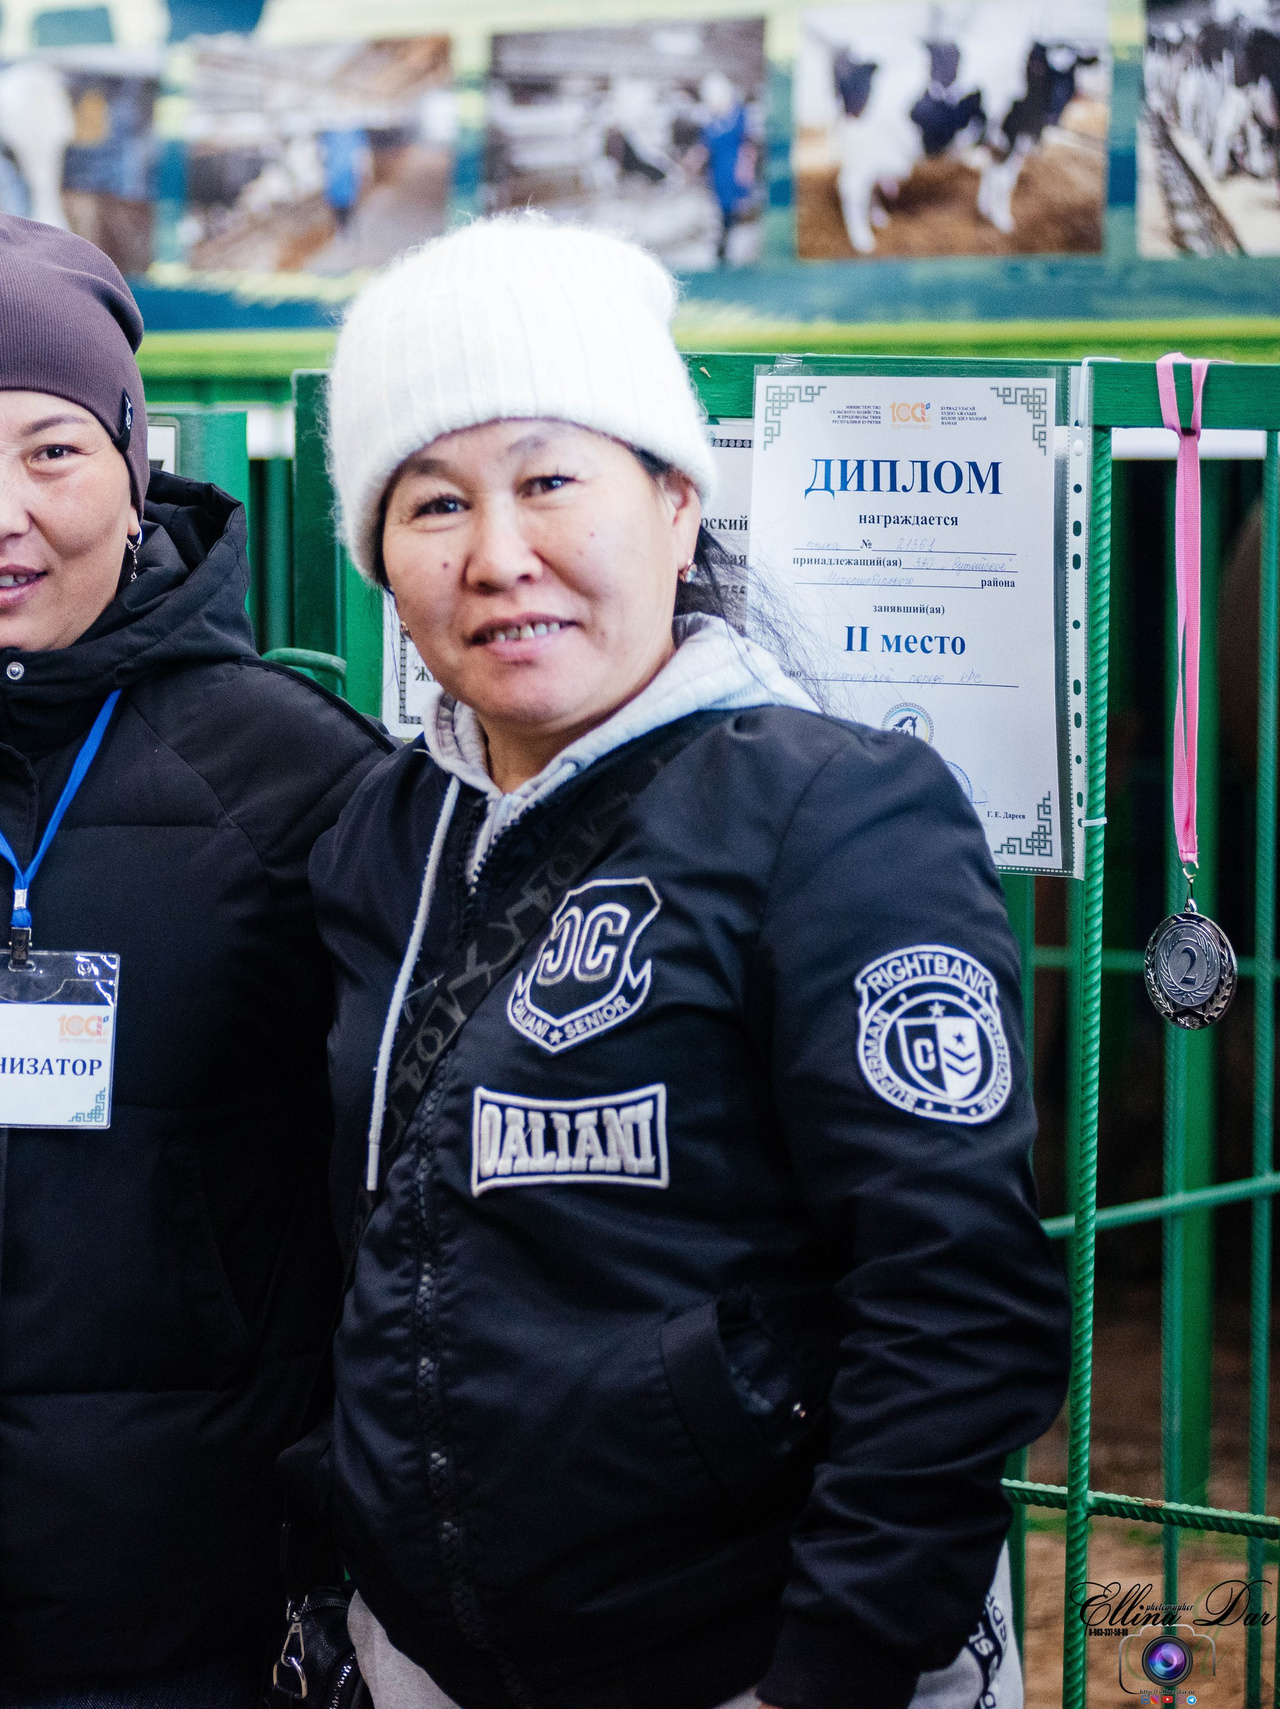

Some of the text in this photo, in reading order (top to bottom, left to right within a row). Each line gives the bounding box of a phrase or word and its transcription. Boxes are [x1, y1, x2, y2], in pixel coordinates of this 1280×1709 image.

[804, 458, 1004, 500] ДИПЛОМ
[858, 513, 960, 528] награждается
[792, 556, 903, 569] принадлежащий(ая)
[981, 578, 1017, 590] района
[872, 604, 946, 617] занявший(ая)
[843, 625, 967, 656] II место
[866, 953, 994, 1000] RIGHTBANK
[1179, 945, 1199, 986] 2
[563, 995, 631, 1040] SENIOR
[863, 1008, 920, 1107] SUPERMAN
[913, 1037, 937, 1072] C
